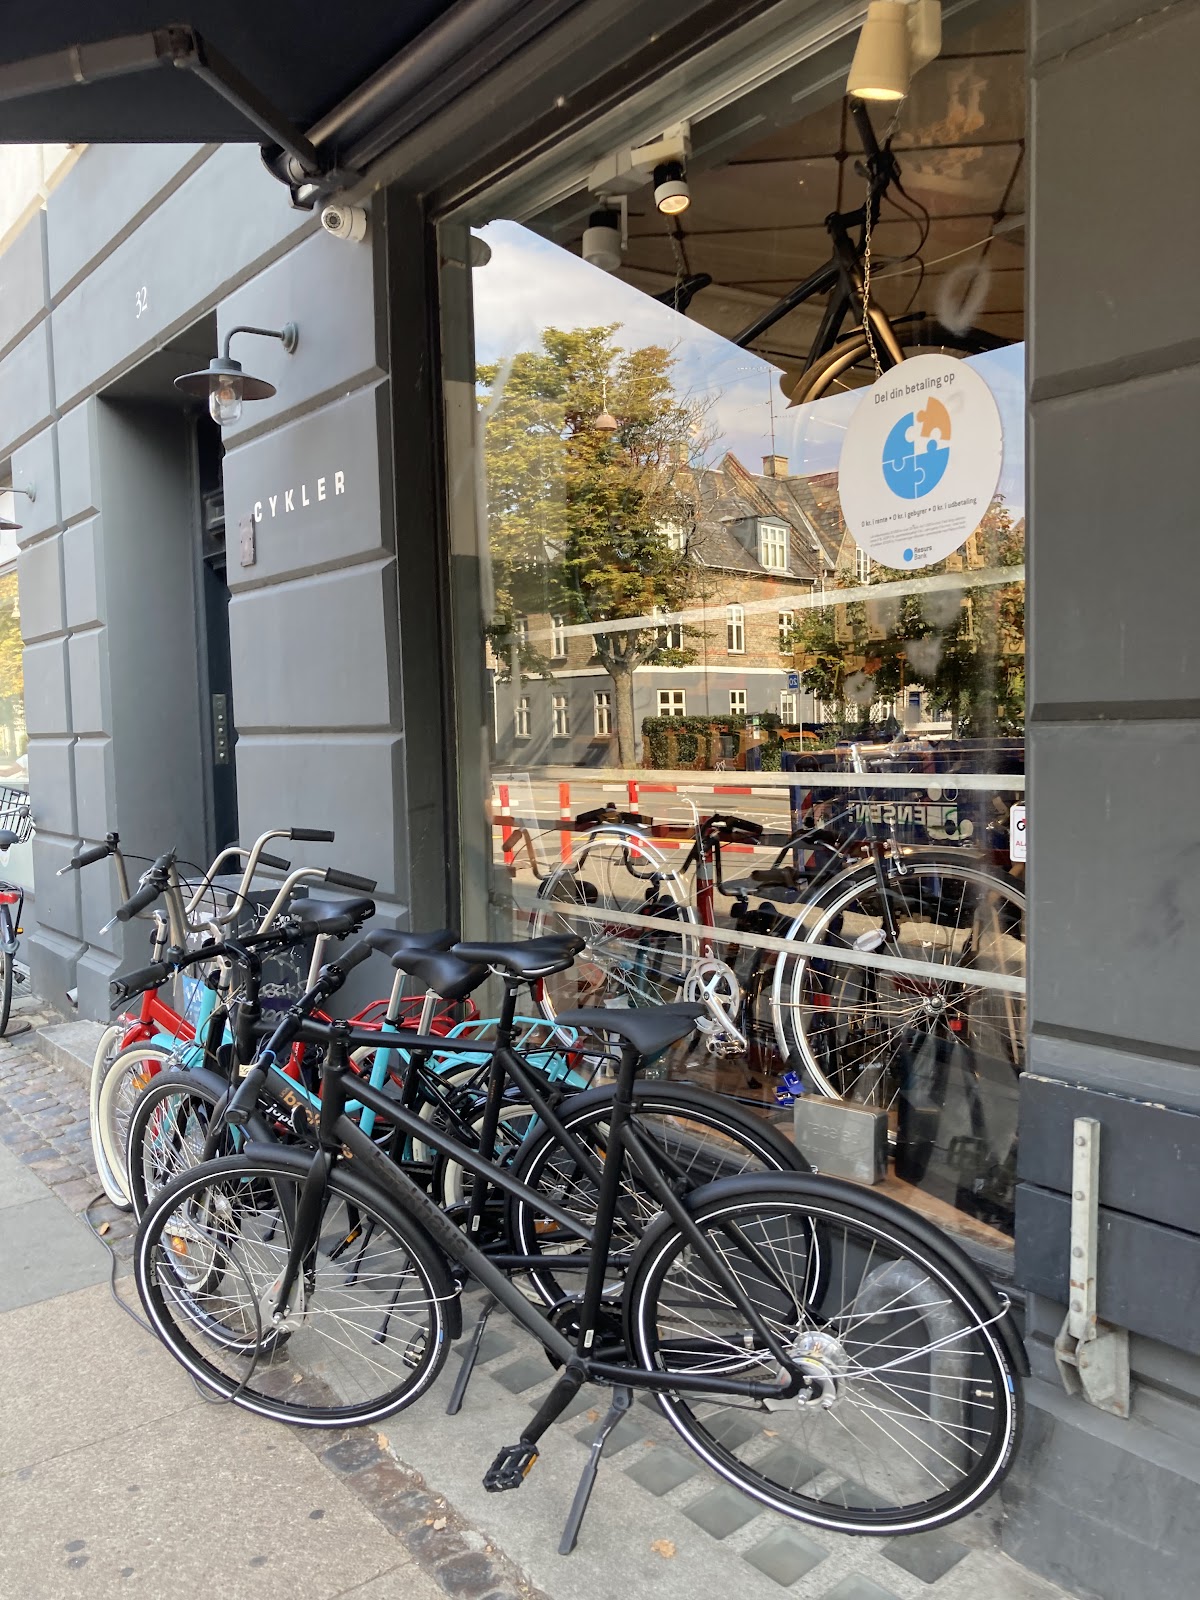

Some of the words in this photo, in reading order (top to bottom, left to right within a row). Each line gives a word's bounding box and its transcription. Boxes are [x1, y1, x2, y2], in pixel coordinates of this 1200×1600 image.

[135, 286, 148, 319] 32
[874, 391, 888, 404] Del
[890, 388, 903, 399] din
[905, 377, 942, 395] betaling
[943, 373, 955, 384] op
[254, 470, 345, 523] CYKLER
[907, 508, 928, 519] gebyrer
[947, 498, 977, 508] udbetaling
